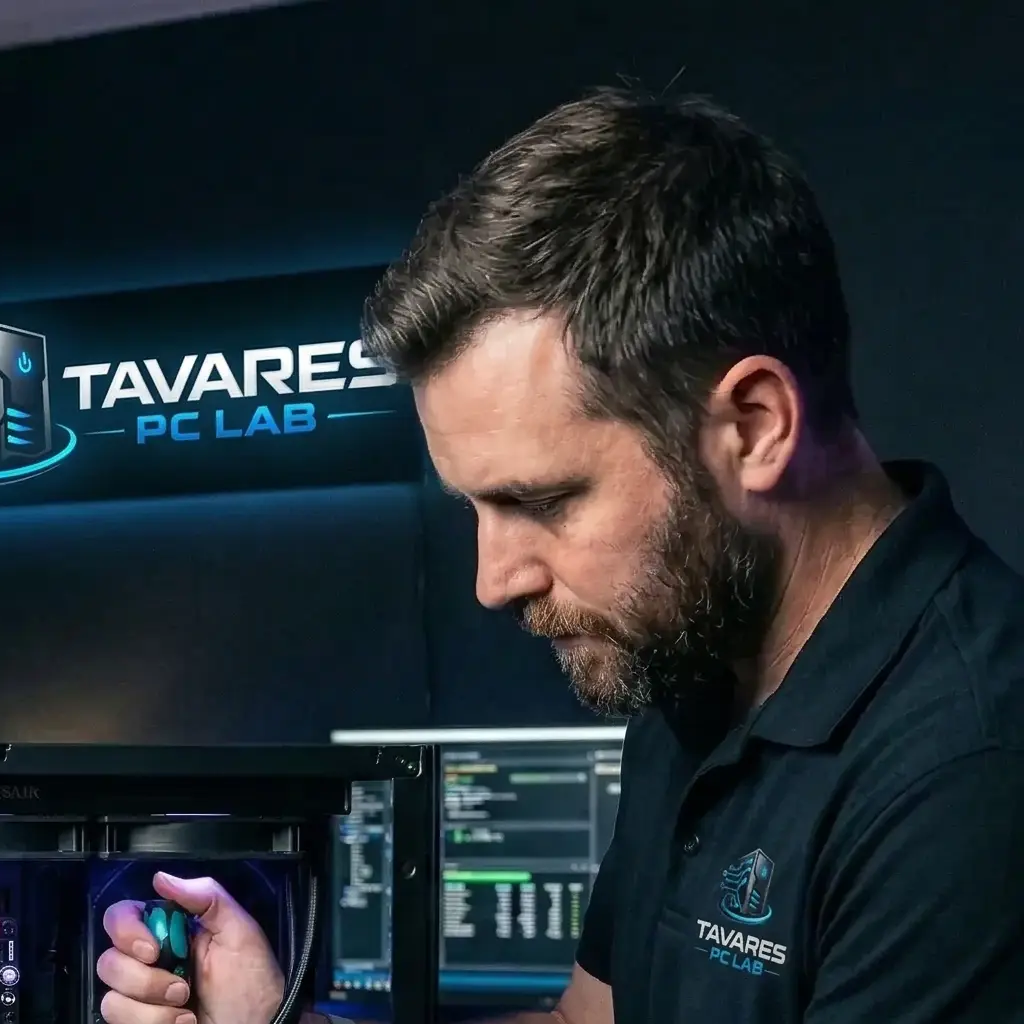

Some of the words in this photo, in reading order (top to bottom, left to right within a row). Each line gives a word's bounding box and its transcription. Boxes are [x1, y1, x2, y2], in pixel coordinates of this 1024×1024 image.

[62, 339, 397, 410] TAVARES
[136, 412, 200, 444] PC
[215, 402, 317, 438] LAB
[697, 919, 787, 965] TAVARES
[710, 947, 730, 965] PC
[732, 956, 763, 975] LAB
